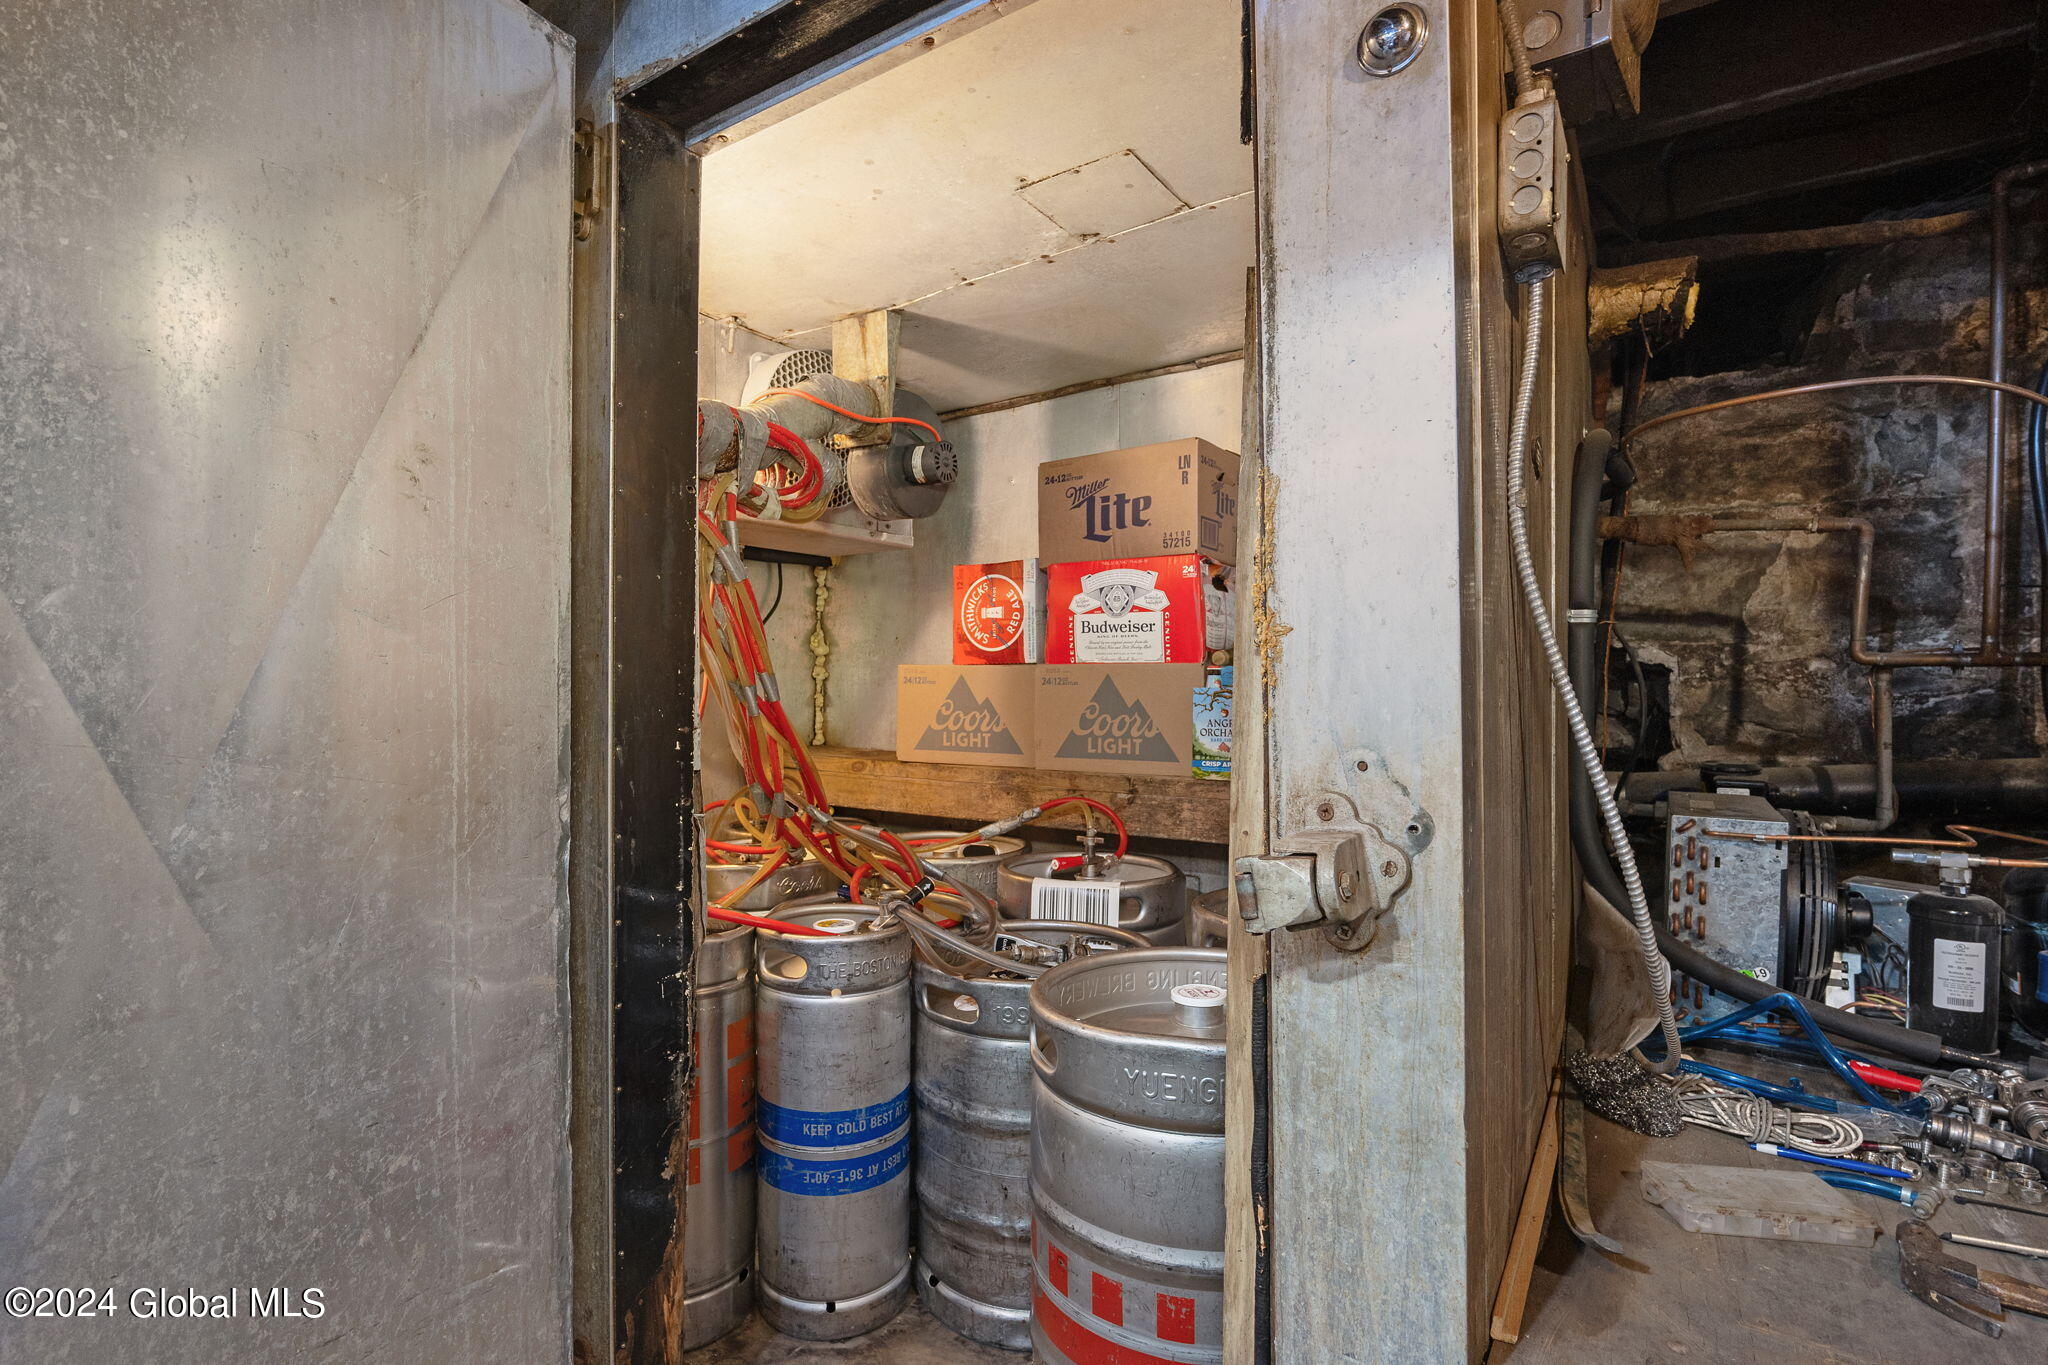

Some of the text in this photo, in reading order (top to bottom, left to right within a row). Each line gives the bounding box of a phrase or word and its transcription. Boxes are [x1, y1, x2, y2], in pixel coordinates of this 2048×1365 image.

[1178, 455, 1191, 470] LN
[1181, 471, 1189, 485] R
[1066, 478, 1110, 505] Miller
[1069, 493, 1152, 543] Lite
[1162, 537, 1191, 549] 57215
[1182, 565, 1195, 573] 24
[1006, 589, 1021, 634] RED ALE
[1081, 620, 1156, 634] Budweiser
[929, 699, 1007, 732] Coors
[1072, 702, 1160, 738] Coors
[943, 732, 992, 748] LIGHT
[1087, 738, 1143, 756] LIGHT
[818, 962, 847, 981] THE
[853, 955, 897, 978] BOSTON
[803, 1123, 832, 1136] KEEP
[837, 1120, 866, 1135] COLD
[870, 1110, 893, 1129] BEST
[867, 1163, 879, 1178] AT
[882, 1152, 901, 1172] BEST
